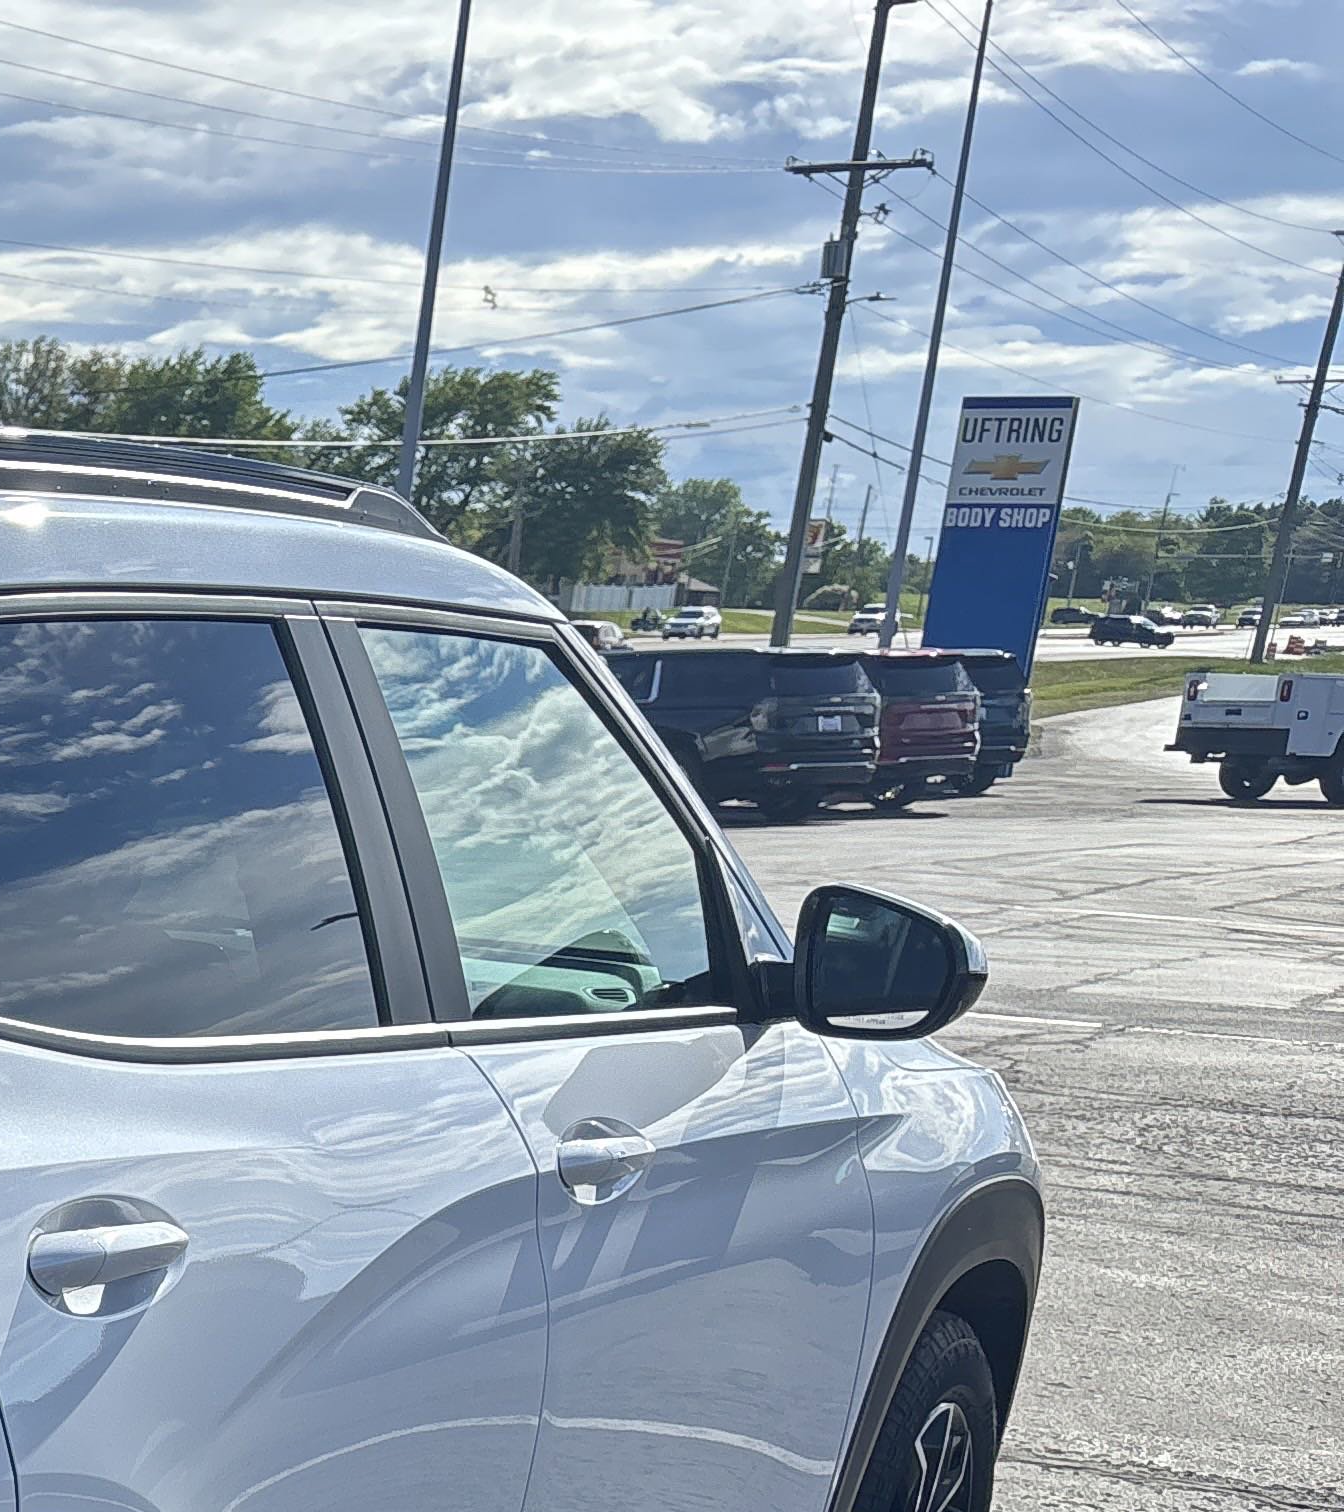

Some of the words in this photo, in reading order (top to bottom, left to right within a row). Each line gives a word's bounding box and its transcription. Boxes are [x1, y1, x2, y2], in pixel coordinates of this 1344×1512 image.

[962, 417, 1064, 443] UFTRING
[959, 486, 1046, 497] CHEVROLET
[944, 507, 993, 528] BODY
[999, 508, 1051, 528] SHOP
